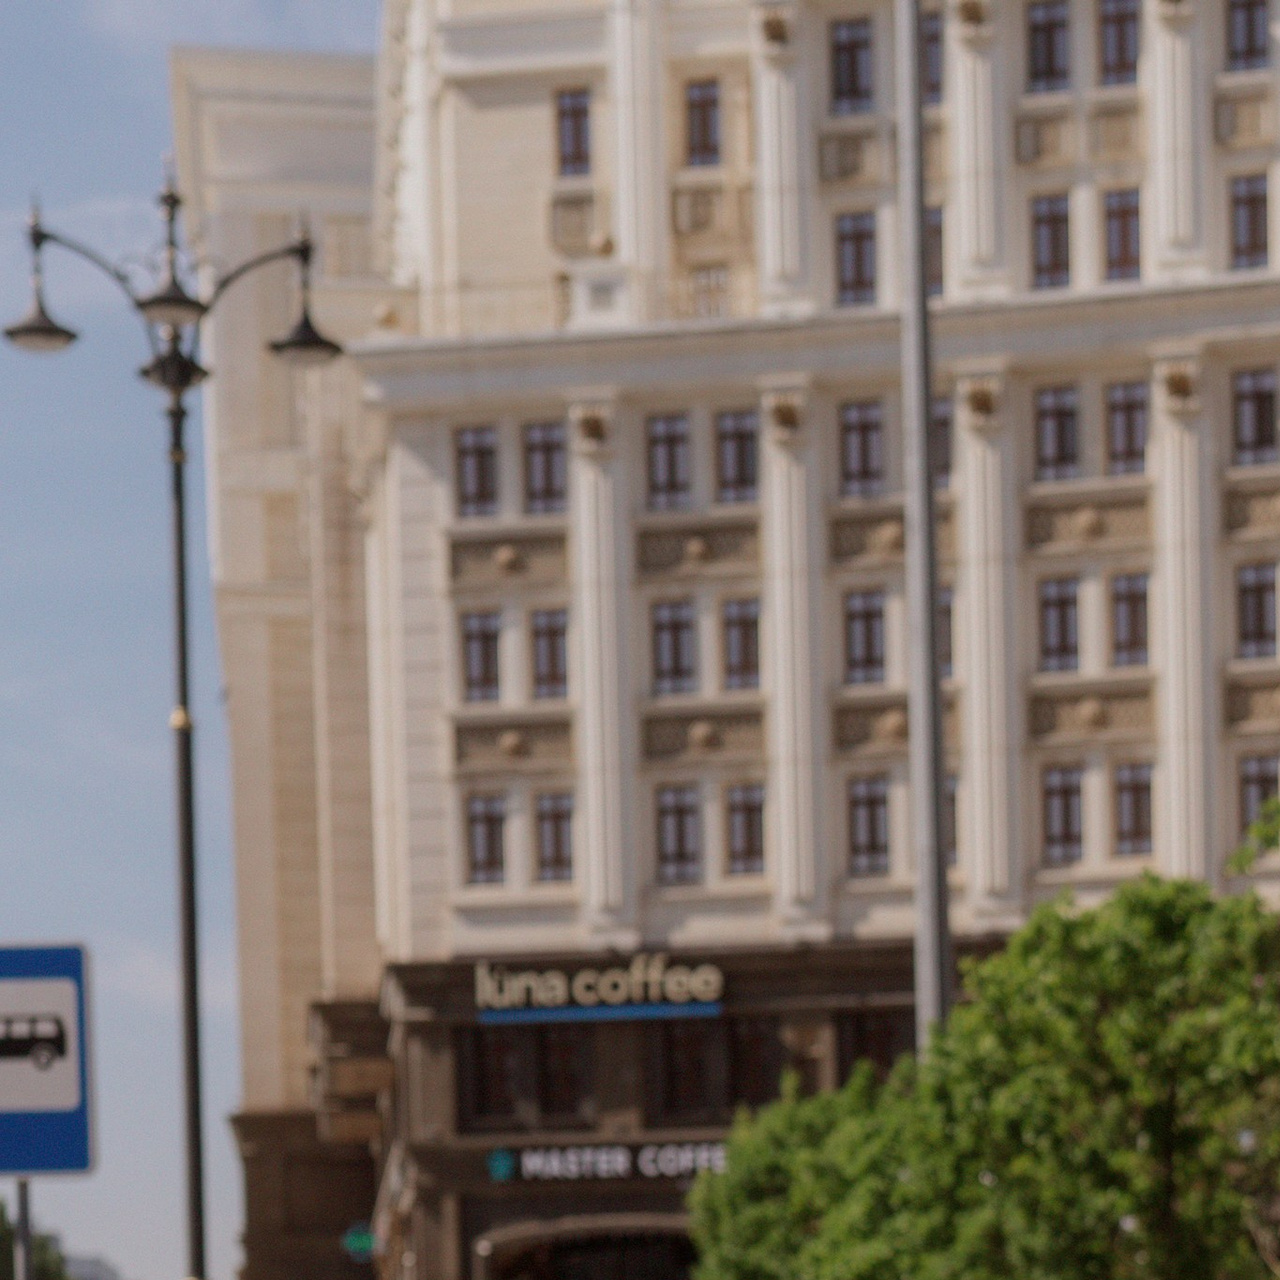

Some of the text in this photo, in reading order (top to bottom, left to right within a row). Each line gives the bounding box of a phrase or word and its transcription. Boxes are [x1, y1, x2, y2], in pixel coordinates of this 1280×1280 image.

[572, 954, 723, 1005] coffee
[520, 1144, 727, 1179] MASTER COFFE
